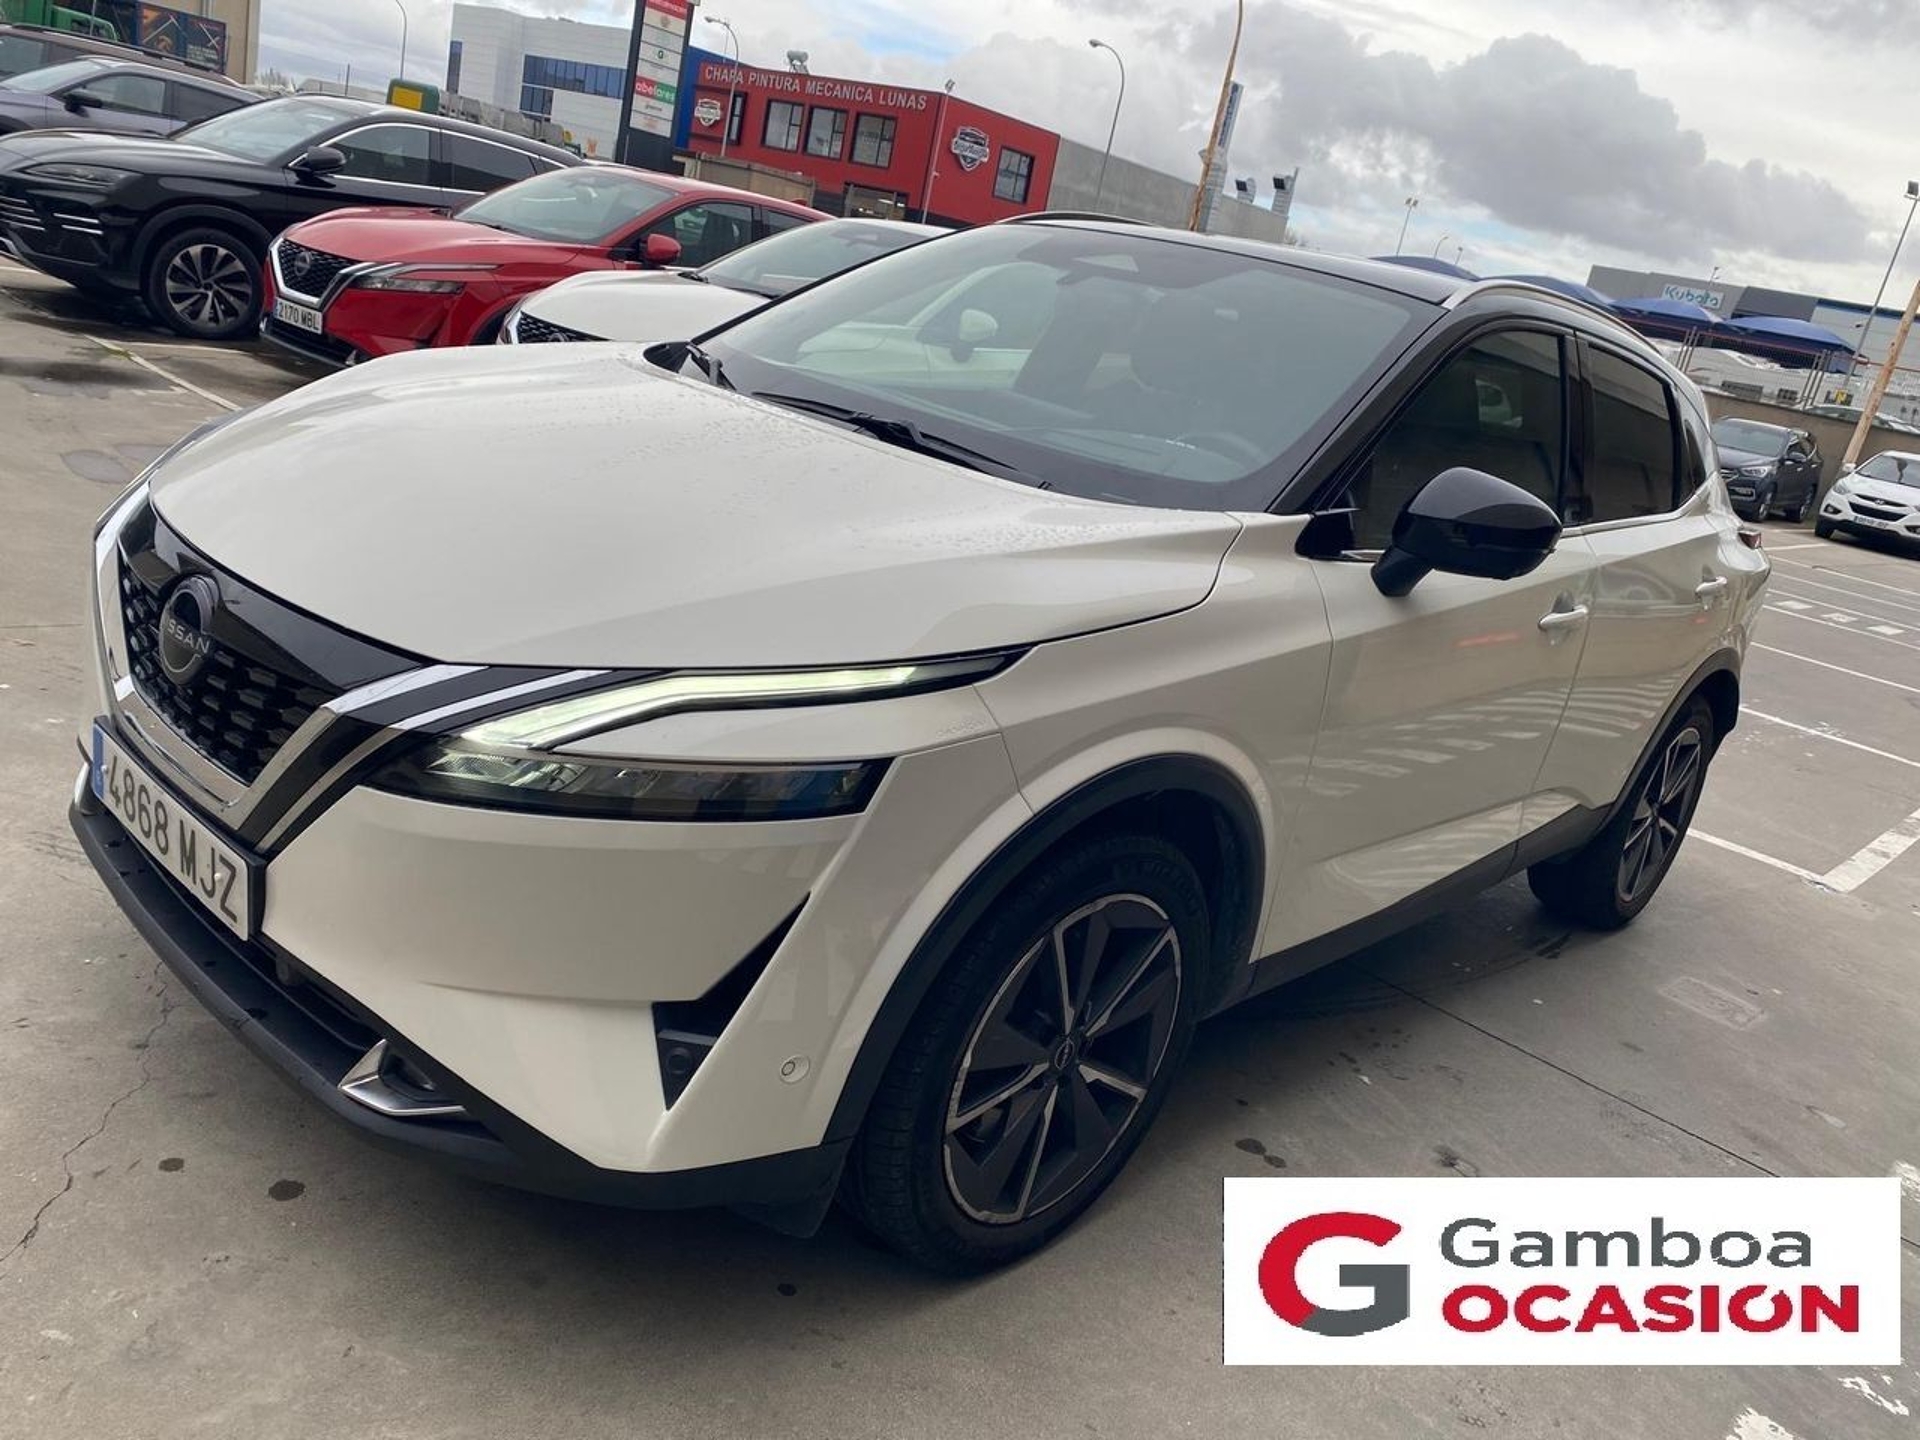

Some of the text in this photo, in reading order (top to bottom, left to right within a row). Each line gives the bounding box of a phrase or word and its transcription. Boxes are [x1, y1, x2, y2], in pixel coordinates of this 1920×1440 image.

[704, 66, 928, 110] CHAPA PINTURA MECANICA LUNAS
[1664, 285, 1719, 307] Kubota
[108, 755, 238, 923] 4868 MJZ
